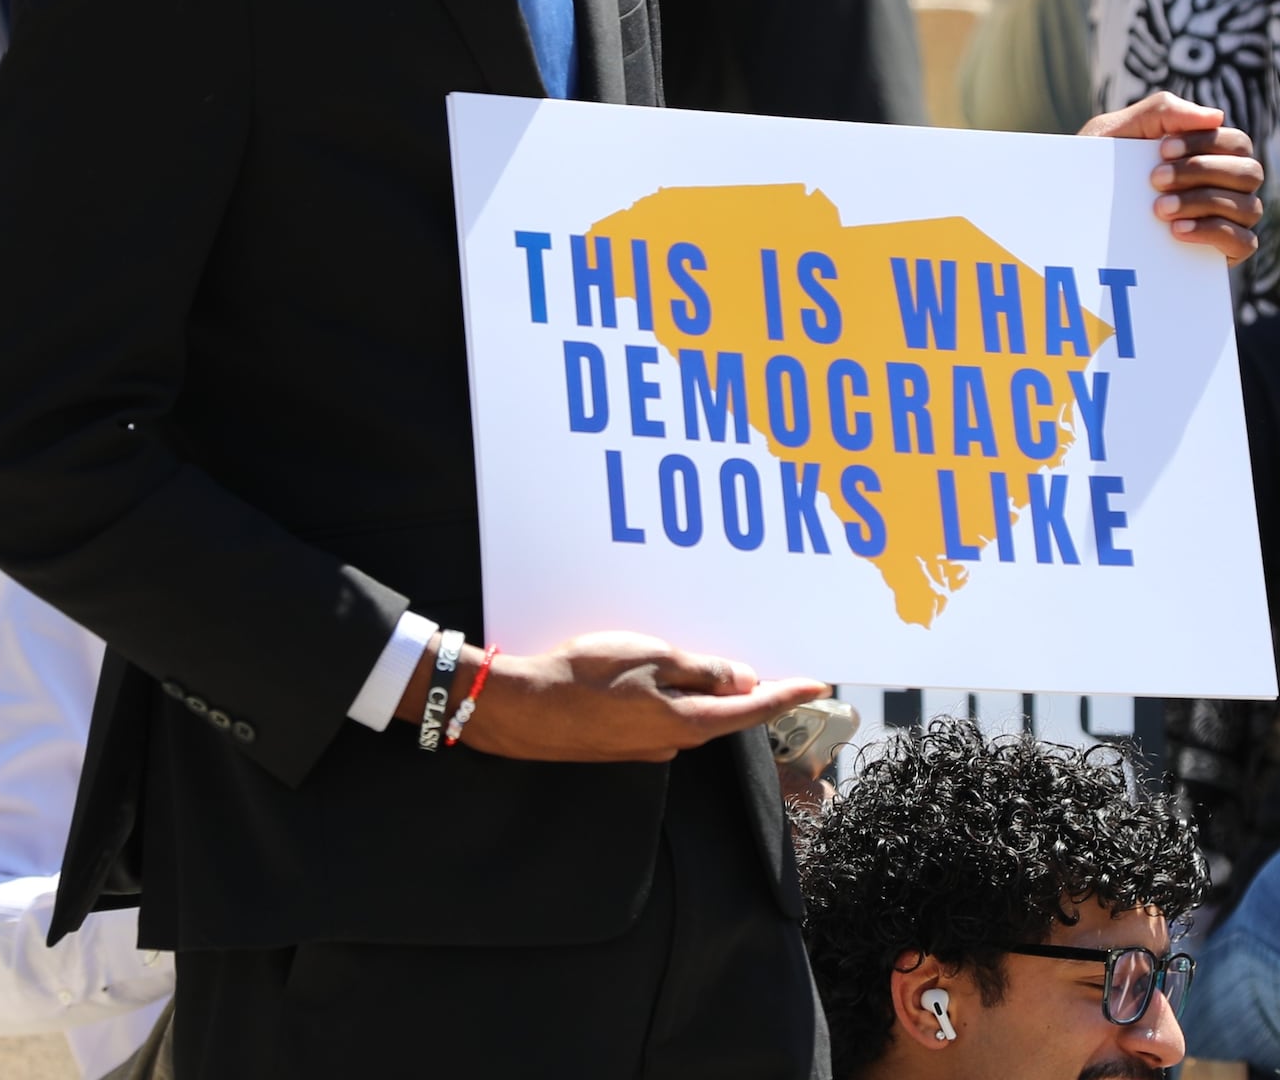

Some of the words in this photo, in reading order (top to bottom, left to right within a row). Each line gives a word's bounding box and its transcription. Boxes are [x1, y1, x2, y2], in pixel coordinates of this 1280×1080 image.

[514, 230, 711, 336] THIS
[760, 248, 842, 344] IS
[889, 257, 1137, 359] WHAT
[564, 340, 1111, 462] DEMOCRACY
[604, 450, 886, 558] LOOKS
[939, 470, 1134, 567] LIKE
